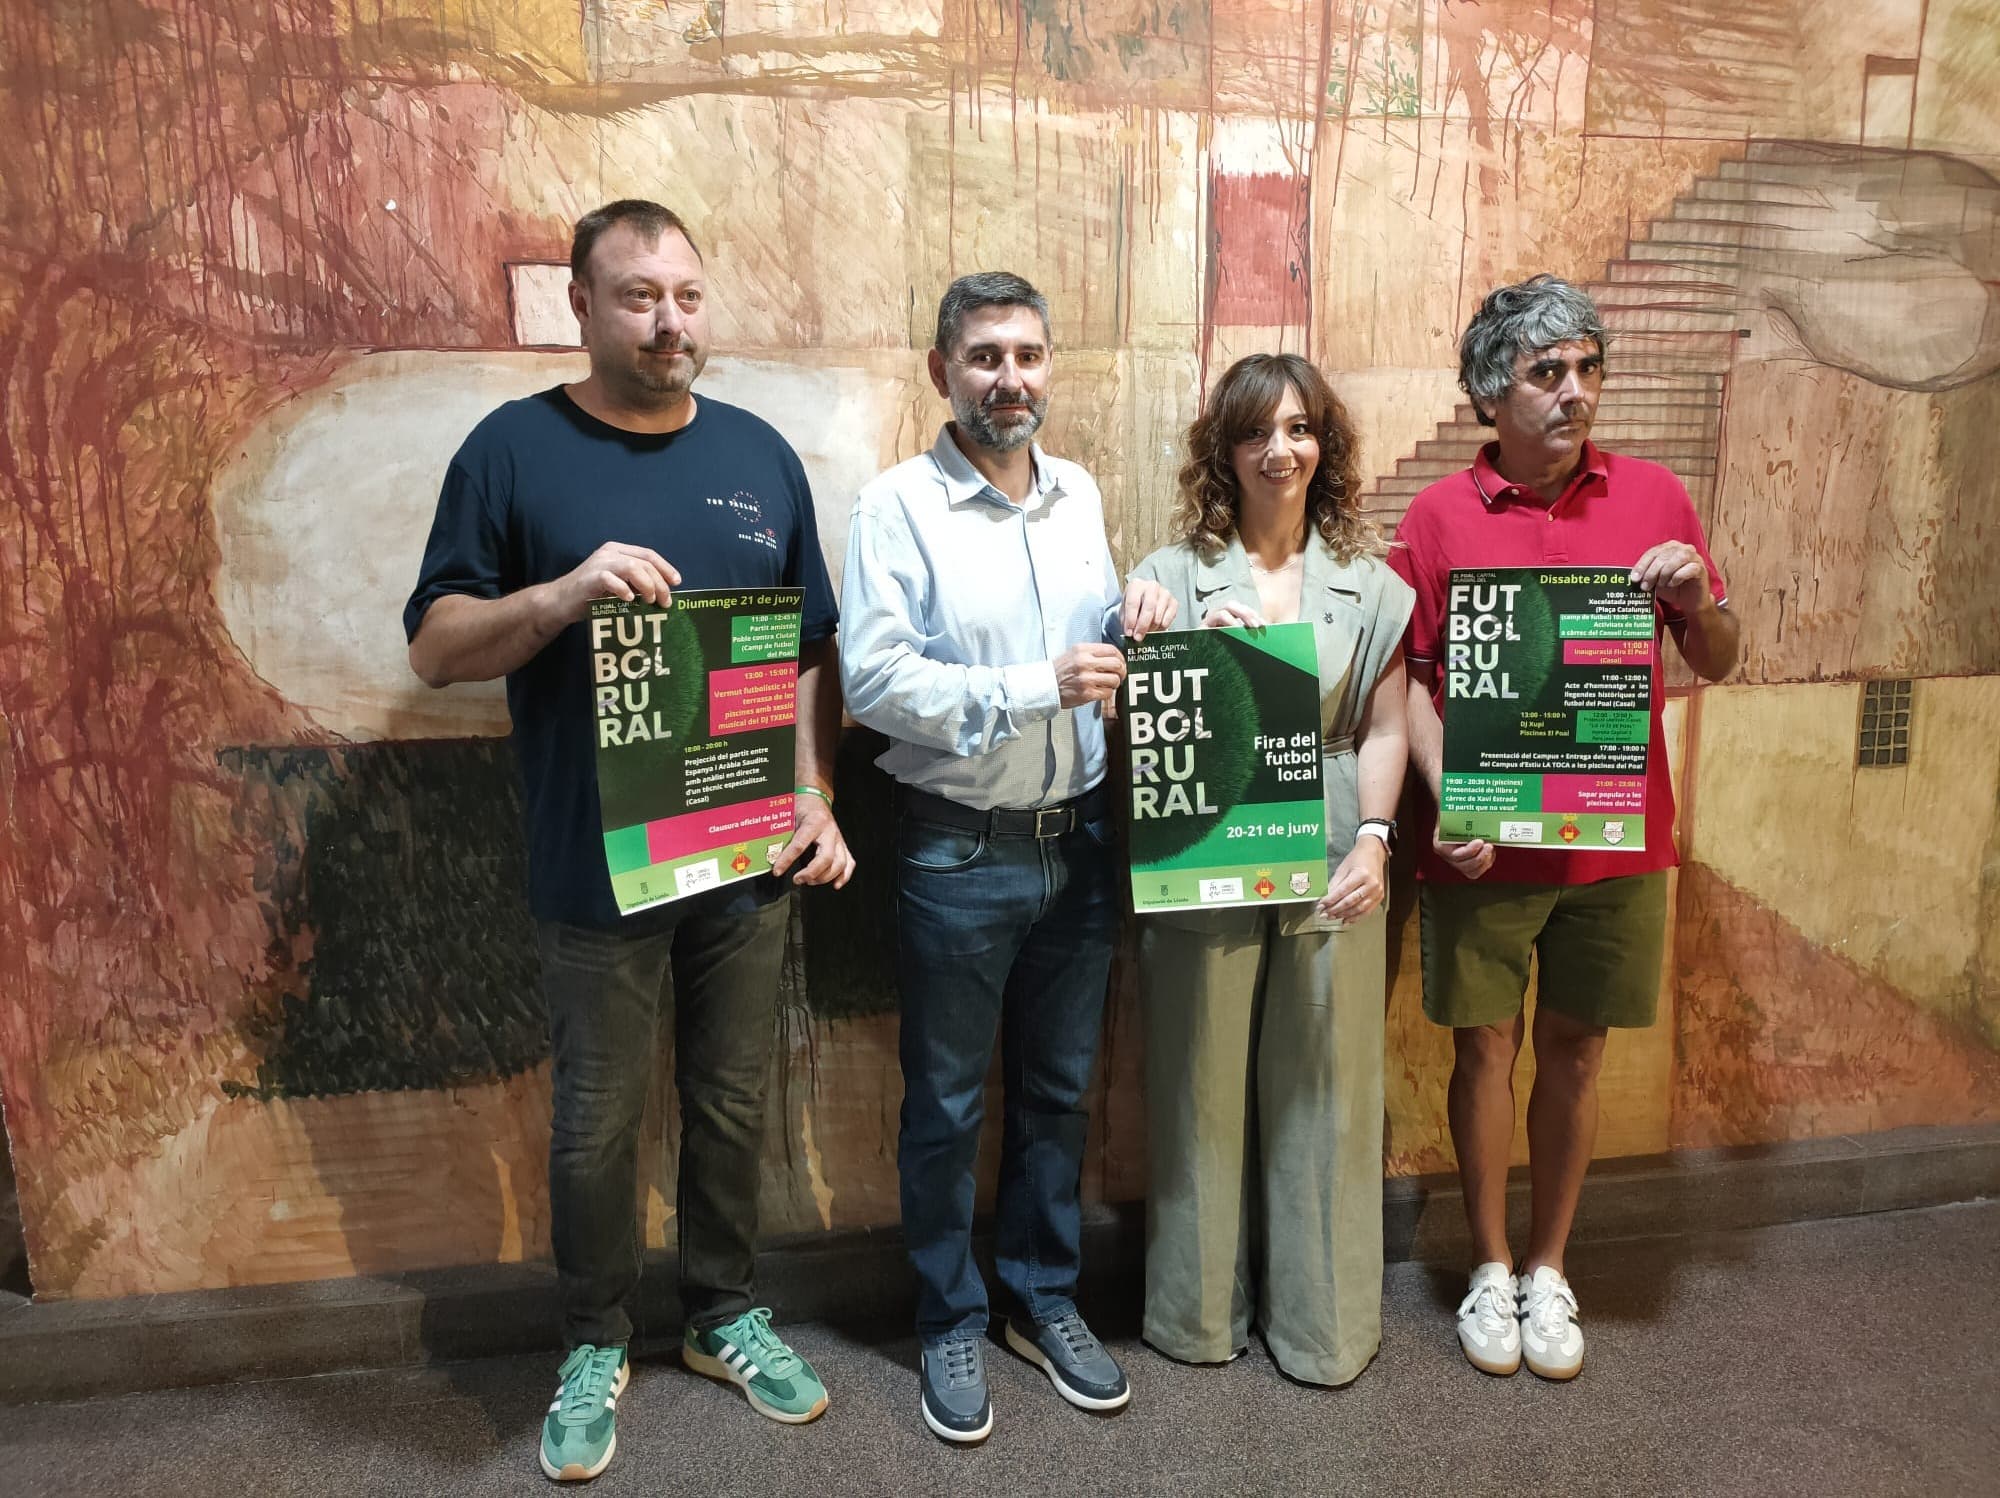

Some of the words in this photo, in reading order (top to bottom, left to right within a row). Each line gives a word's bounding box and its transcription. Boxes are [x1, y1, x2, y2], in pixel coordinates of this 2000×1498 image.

[1540, 575, 1592, 584] Dissabte
[1594, 575, 1607, 584] 20
[1612, 575, 1625, 584] de
[678, 598, 737, 610] Diumenge
[741, 596, 753, 606] 21
[758, 595, 771, 604] de
[773, 594, 800, 606] juny
[1451, 585, 1521, 611] FUT
[592, 613, 668, 649] FUT
[750, 624, 769, 632] Partit
[1450, 613, 1520, 641] BOL
[733, 635, 751, 643] Poble
[742, 644, 763, 652] (Camp
[594, 647, 670, 683] BOL
[1127, 653, 1160, 662] MUNDIAL
[1450, 644, 1499, 670] RU
[714, 689, 742, 698] Vermut
[1128, 668, 1209, 706] FUT
[1450, 672, 1519, 699] RAL
[596, 681, 649, 716] RU
[743, 696, 772, 705] terrassa
[718, 719, 746, 729] musical
[748, 717, 759, 725] del
[761, 716, 768, 724] DJ
[771, 712, 794, 722] TXEMA
[725, 708, 754, 720] piscines
[756, 705, 771, 713] amb
[600, 710, 672, 748] RAL
[1130, 707, 1213, 745] BOL
[1254, 735, 1286, 750] Fira
[1291, 732, 1316, 747] del
[685, 755, 716, 766] Projecció
[730, 749, 749, 760] partit
[750, 747, 768, 755] entre
[1131, 745, 1195, 784] RU
[1265, 748, 1316, 766] futbol
[685, 766, 713, 776] Espanya
[686, 778, 701, 786] amb
[736, 768, 759, 777] directe
[1277, 765, 1317, 782] local
[686, 795, 709, 807] (Casal)
[1132, 782, 1218, 820] RAL
[1578, 791, 1597, 799] Sopar
[1587, 800, 1613, 808] piscines
[709, 822, 739, 833] Clausura
[740, 817, 761, 827] oficial
[1227, 824, 1262, 838] 20-21
[1268, 823, 1284, 835] de
[1287, 822, 1319, 838] juny
